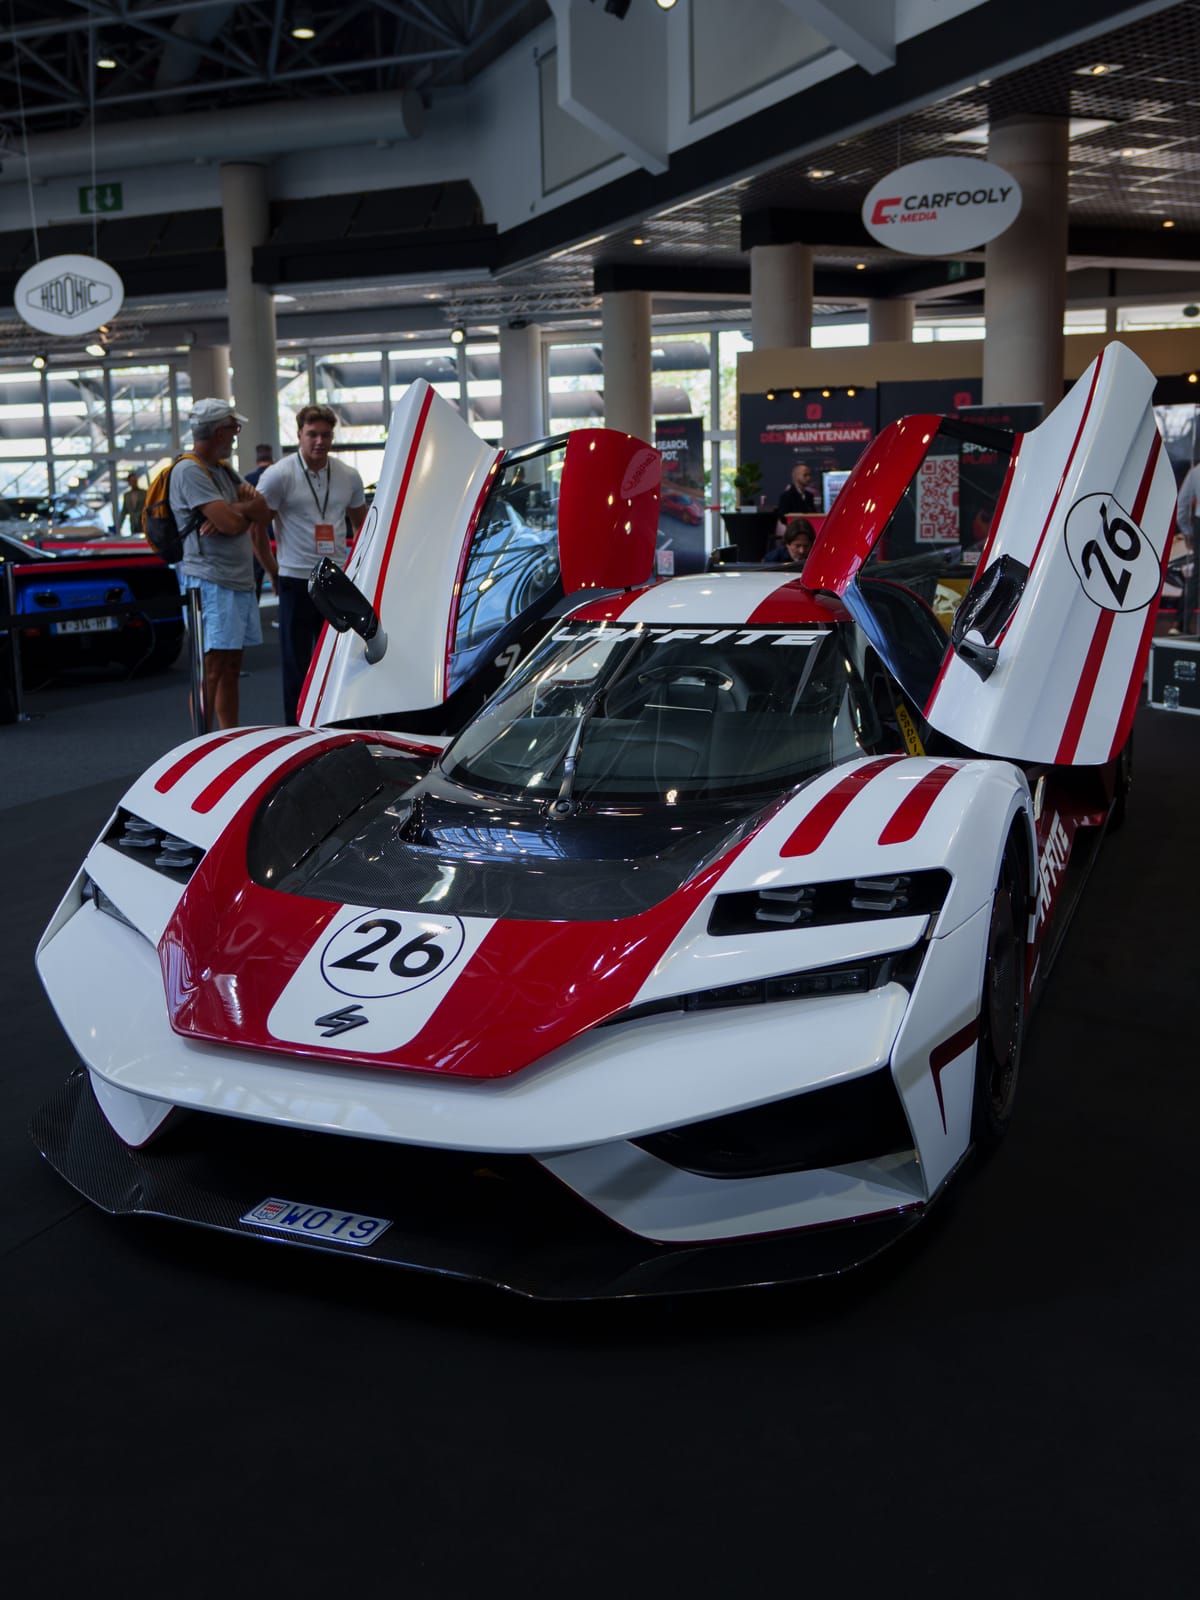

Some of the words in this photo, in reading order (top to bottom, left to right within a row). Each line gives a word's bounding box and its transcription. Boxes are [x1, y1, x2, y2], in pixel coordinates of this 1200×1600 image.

[904, 186, 1013, 210] CARFOOLY
[900, 211, 938, 223] MEDIA
[785, 429, 869, 443] MAINTENANT
[1081, 502, 1141, 608] 26
[328, 918, 446, 978] 26
[280, 1206, 379, 1239] W019
